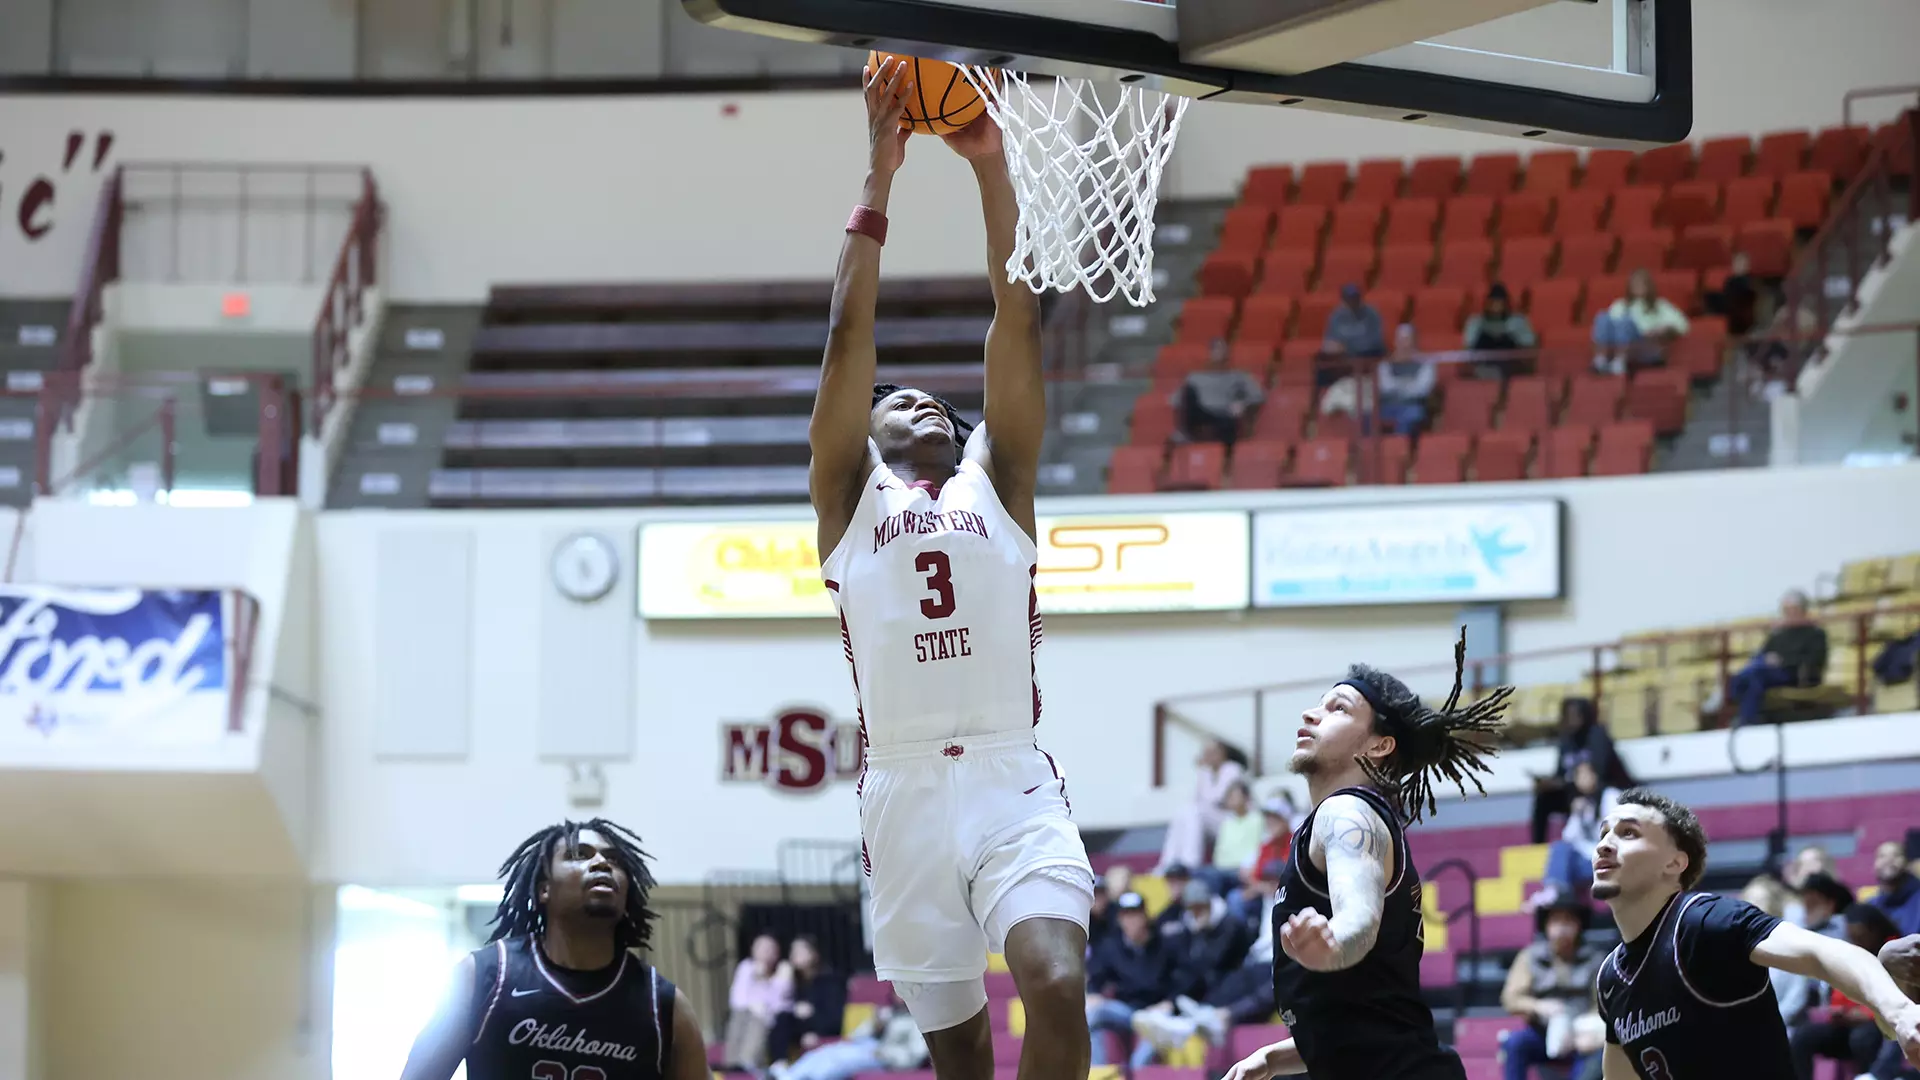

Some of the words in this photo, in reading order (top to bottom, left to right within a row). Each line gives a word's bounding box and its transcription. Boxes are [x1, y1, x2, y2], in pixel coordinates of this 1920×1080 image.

[873, 509, 989, 554] MIDWESTERN
[915, 550, 957, 620] 3
[0, 586, 213, 698] Ford
[914, 627, 972, 663] STATE
[508, 1017, 637, 1061] Oklahoma
